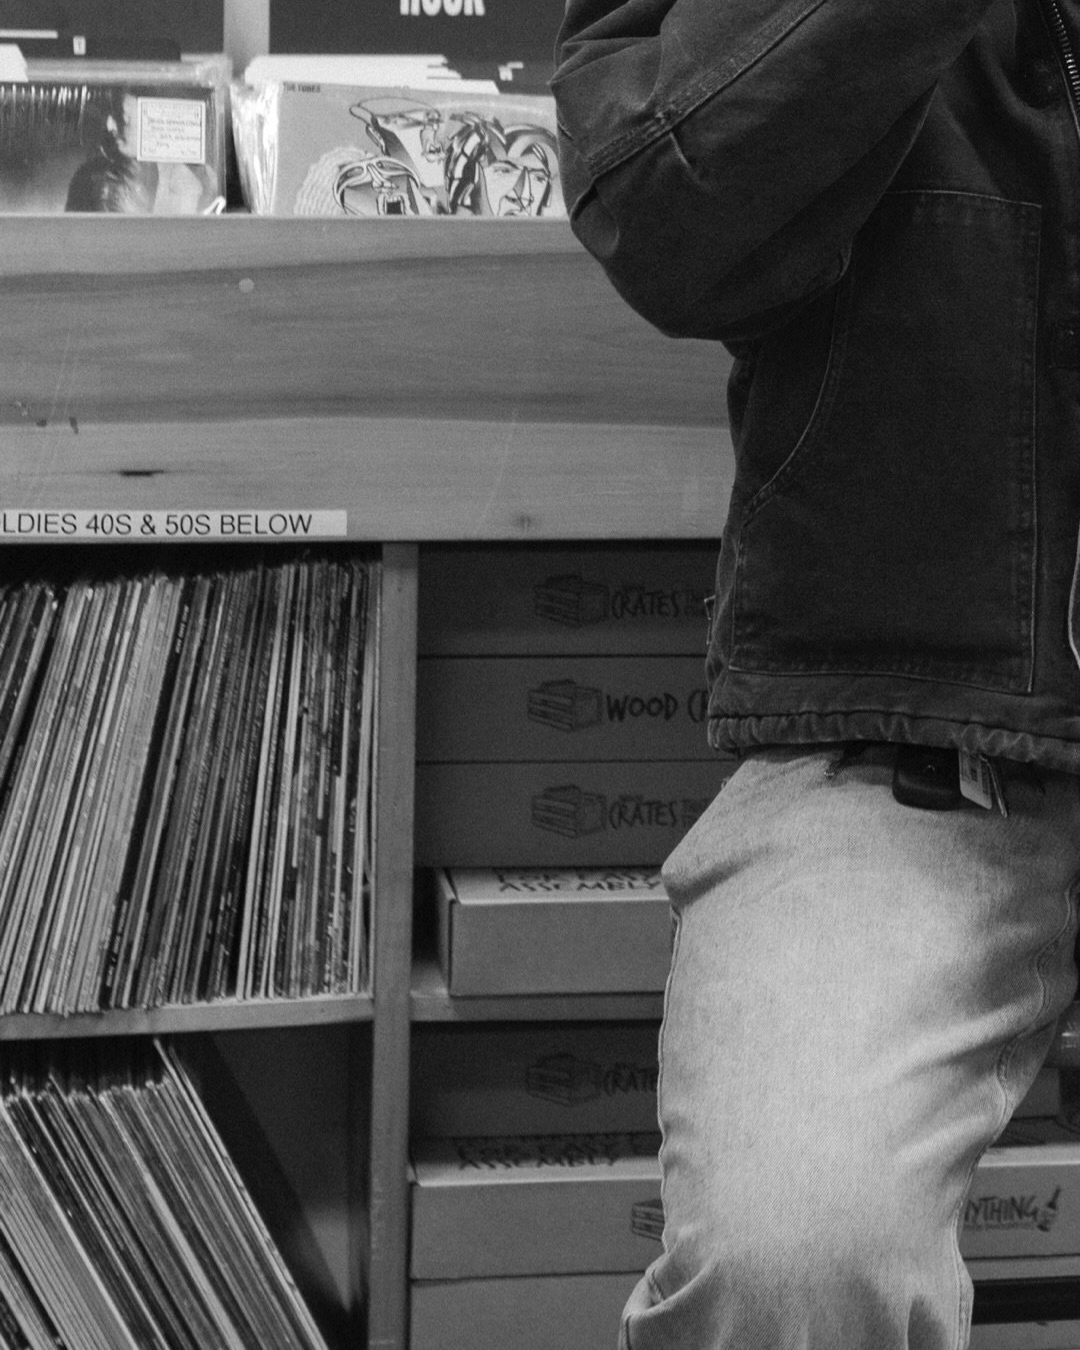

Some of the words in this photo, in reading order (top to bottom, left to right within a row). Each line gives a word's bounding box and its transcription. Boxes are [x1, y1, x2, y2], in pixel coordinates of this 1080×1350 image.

[85, 514, 132, 535] 40S
[140, 515, 156, 535] &
[164, 514, 211, 535] 50S
[220, 513, 313, 535] BELOW
[606, 692, 679, 723] WOOD
